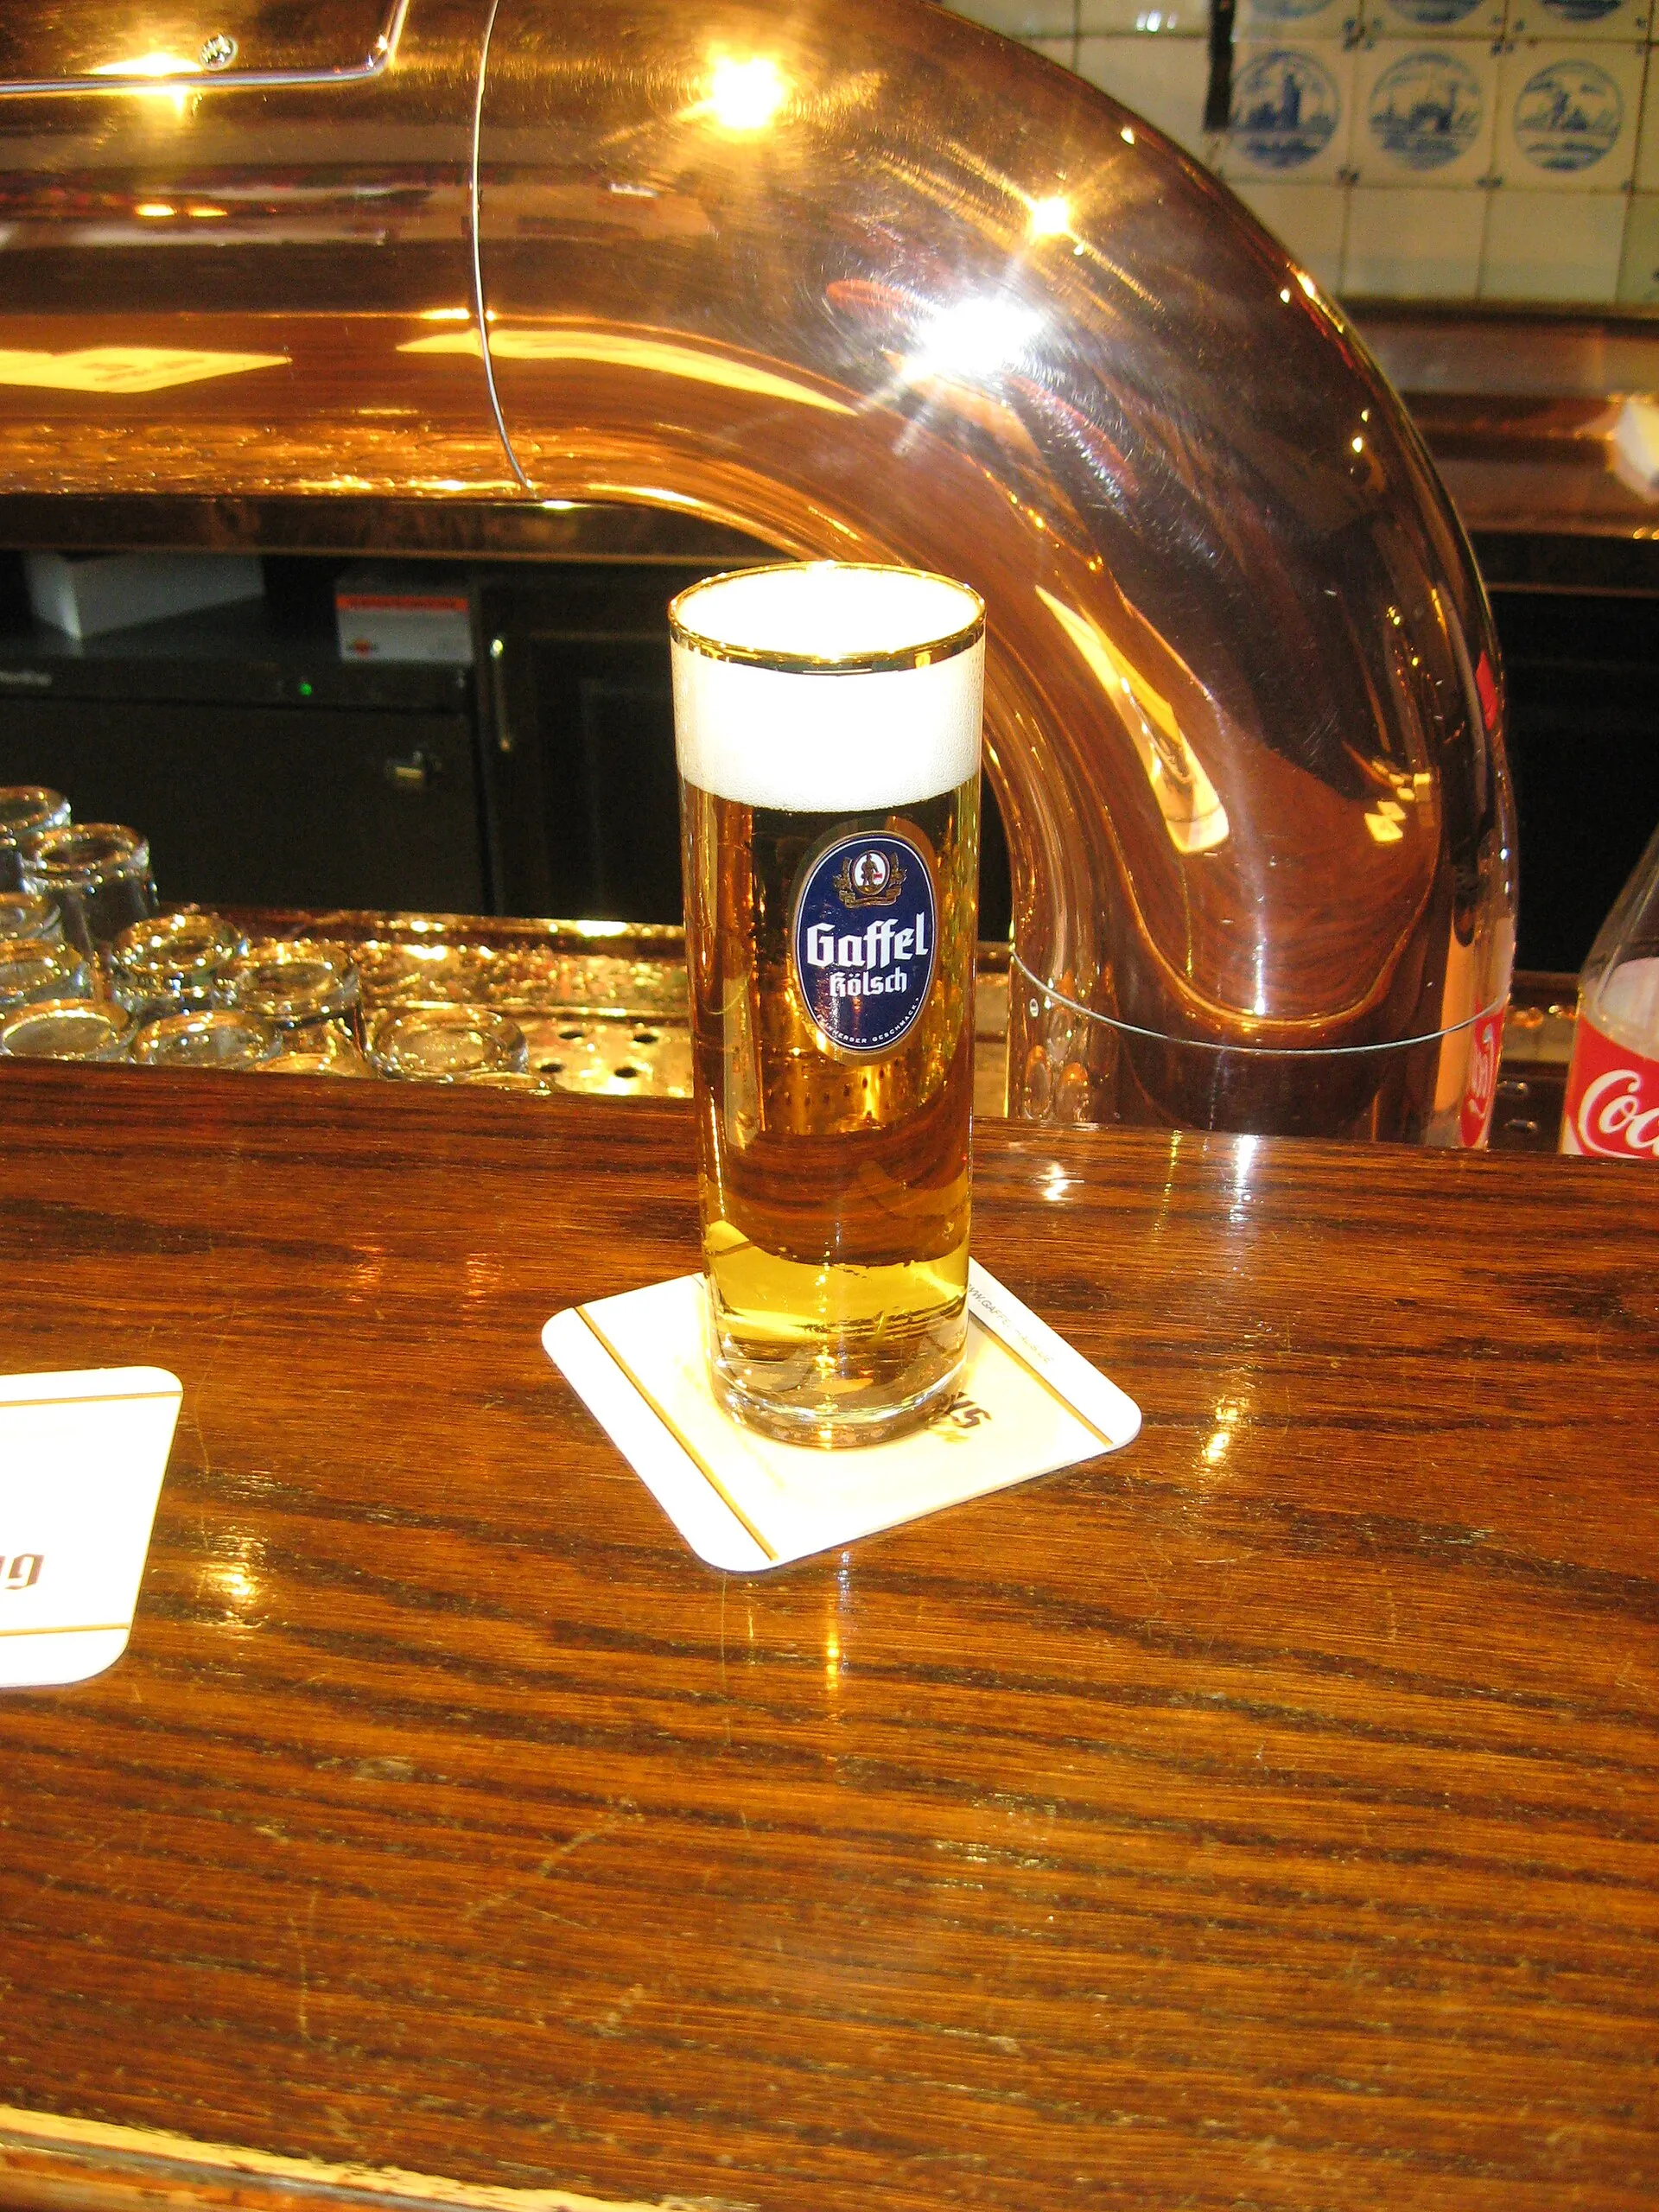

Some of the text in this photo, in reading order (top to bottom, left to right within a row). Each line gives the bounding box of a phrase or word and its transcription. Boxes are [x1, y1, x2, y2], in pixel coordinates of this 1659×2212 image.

[806, 911, 929, 970] Gaffel
[830, 966, 907, 997] Kölsch
[817, 1004, 917, 1043] INHERBER GESCHMACK
[1578, 1069, 1659, 1159] Coc
